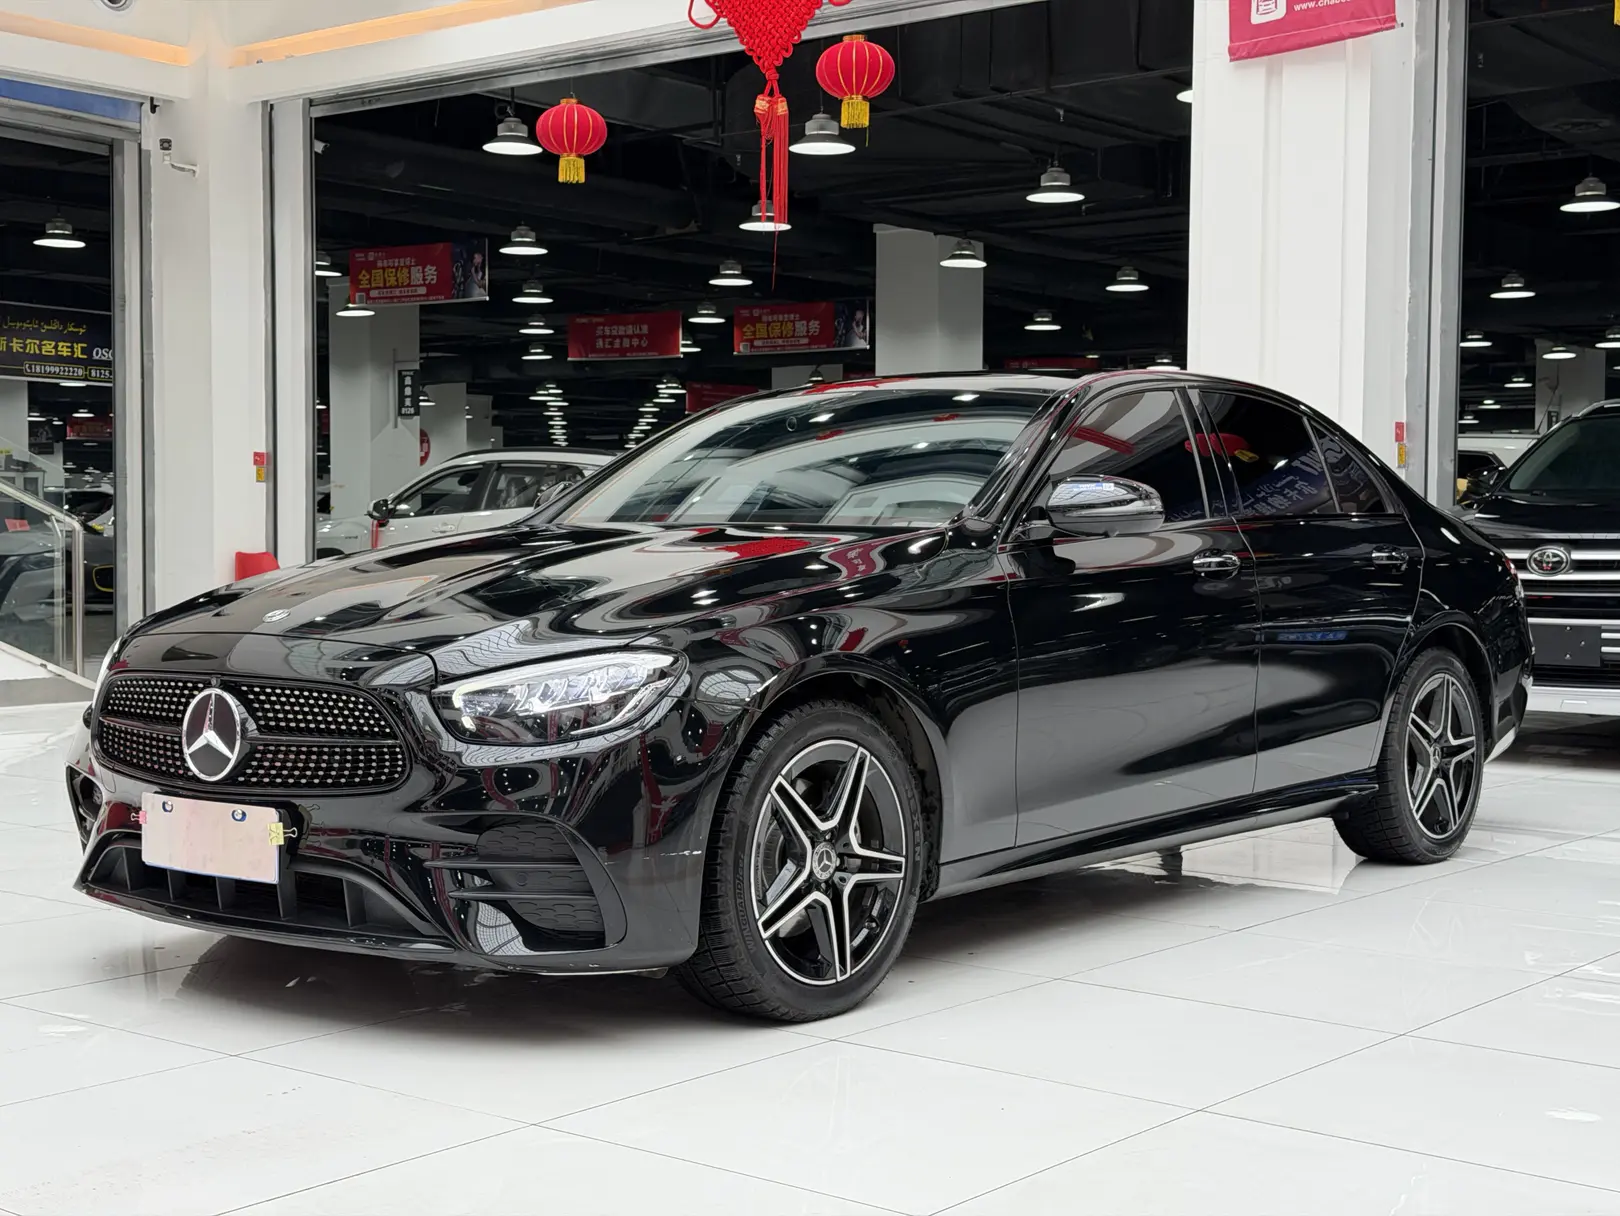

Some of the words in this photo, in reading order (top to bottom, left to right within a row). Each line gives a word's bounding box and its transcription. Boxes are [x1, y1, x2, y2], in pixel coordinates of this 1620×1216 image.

[358, 264, 438, 288] 全国保修服务
[742, 320, 821, 339] 全国保修服务
